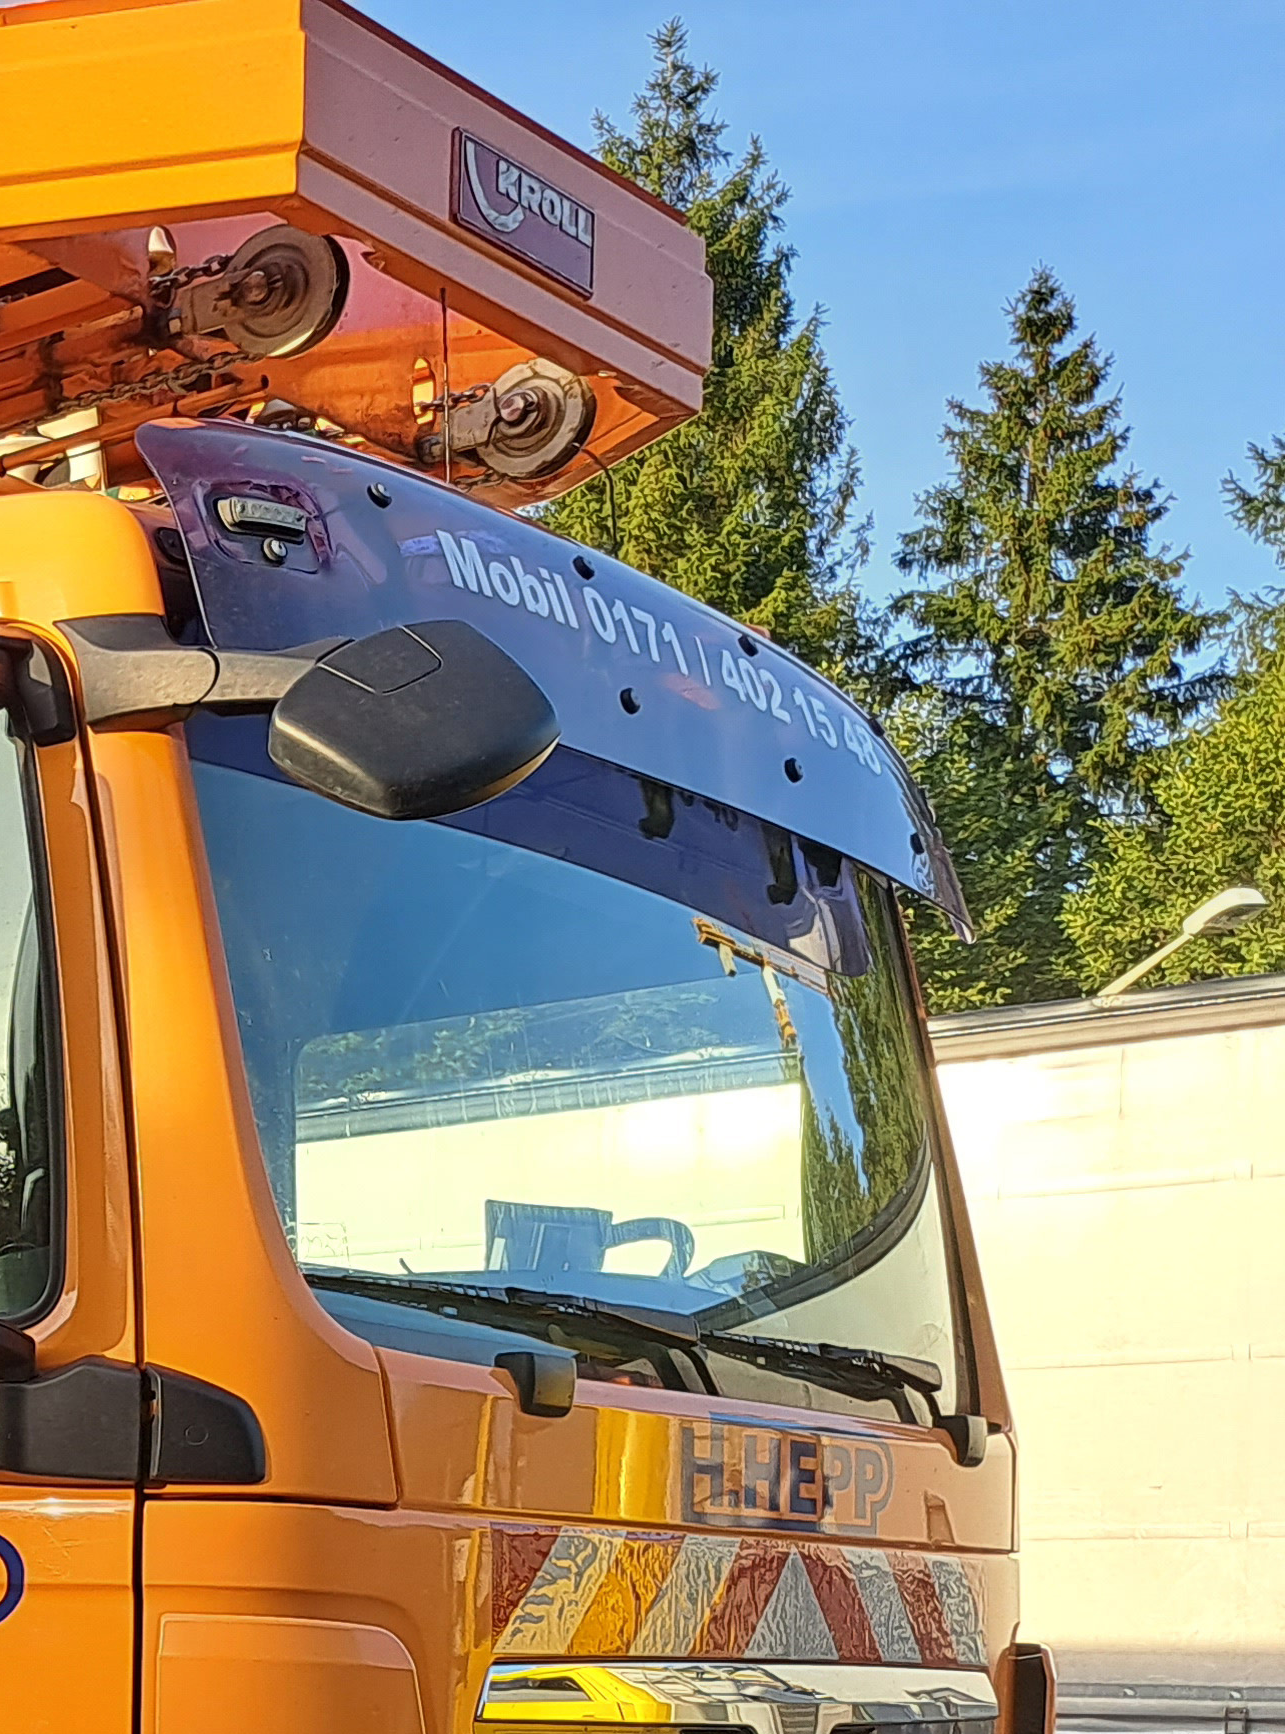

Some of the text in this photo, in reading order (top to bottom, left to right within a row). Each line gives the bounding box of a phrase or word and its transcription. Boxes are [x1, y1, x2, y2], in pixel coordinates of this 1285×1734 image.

[497, 158, 593, 248] KROLL
[435, 529, 580, 629] Mobil
[582, 585, 689, 677] 0171
[720, 649, 792, 725] 402
[792, 686, 838, 749] 15
[842, 716, 883, 776] 48
[681, 1411, 894, 1537] H.HEPP
